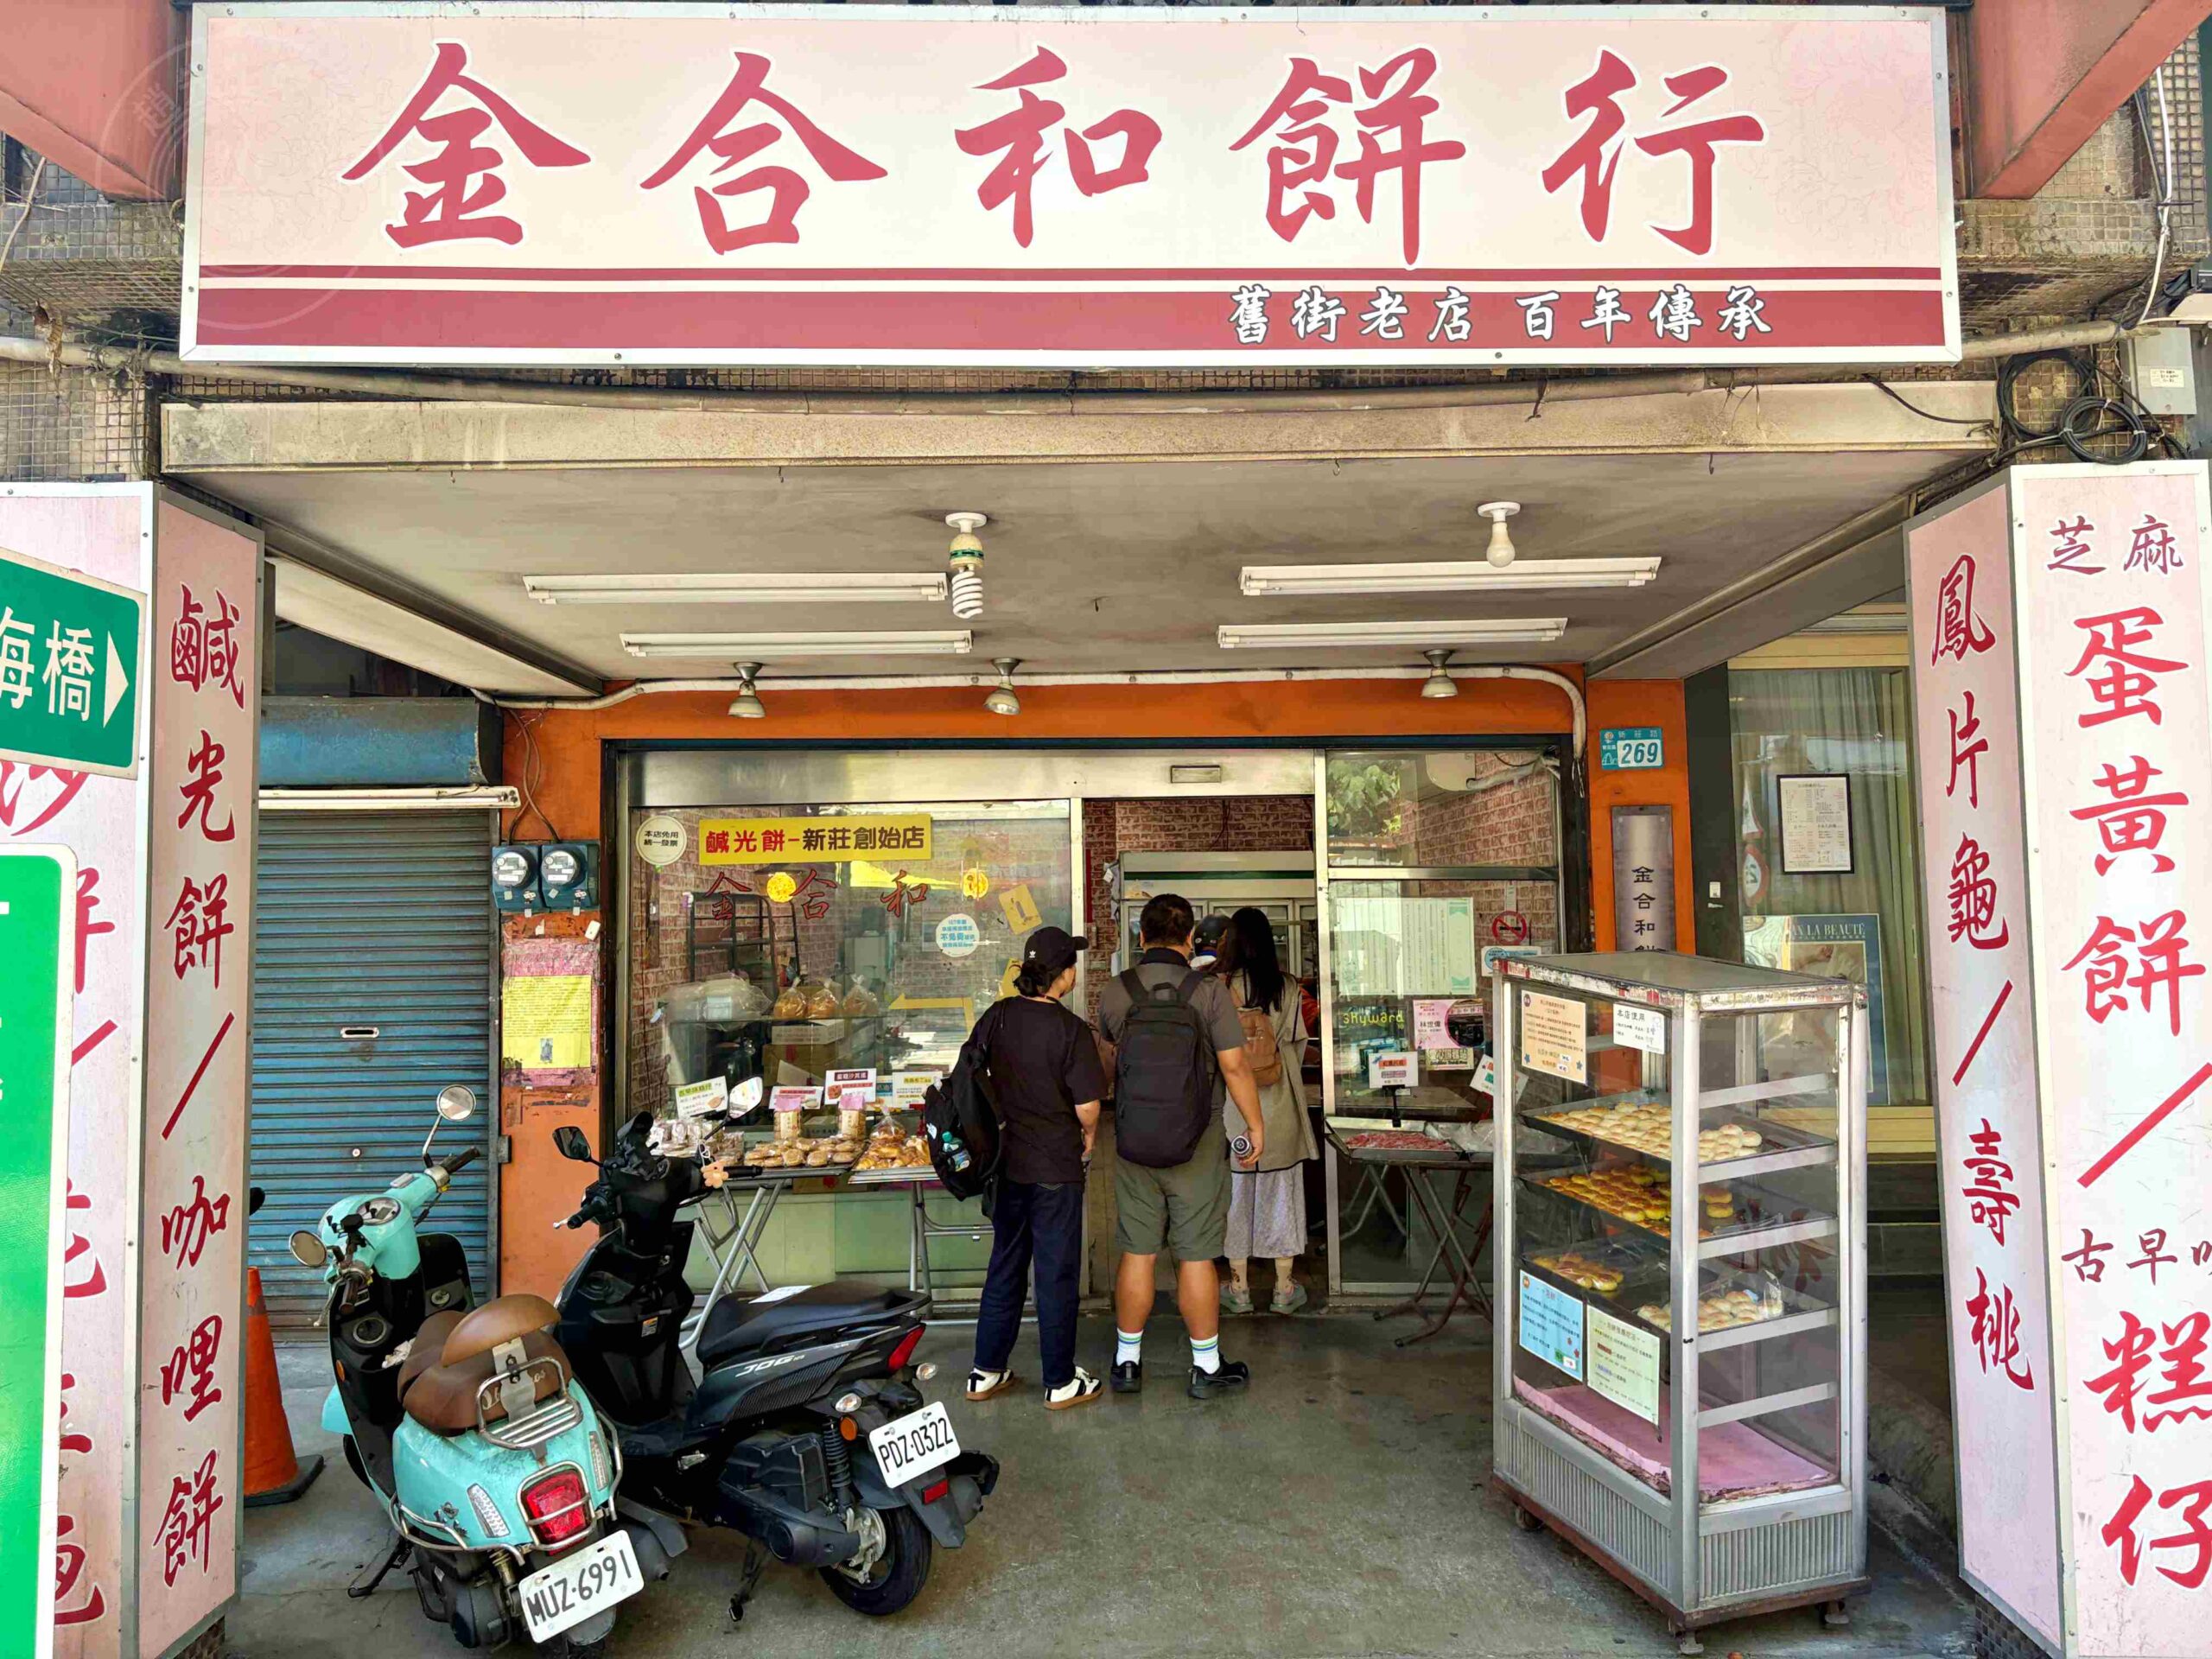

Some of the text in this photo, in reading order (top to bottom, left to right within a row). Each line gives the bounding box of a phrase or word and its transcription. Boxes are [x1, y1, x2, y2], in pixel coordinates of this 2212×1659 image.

[342, 42, 1764, 265] 金合和餅行
[1230, 285, 1773, 344] 舊街老店 百年傳承
[2048, 515, 2183, 575] 芝麻
[1620, 741, 1659, 765] 269
[1631, 866, 1666, 951] 金合和
